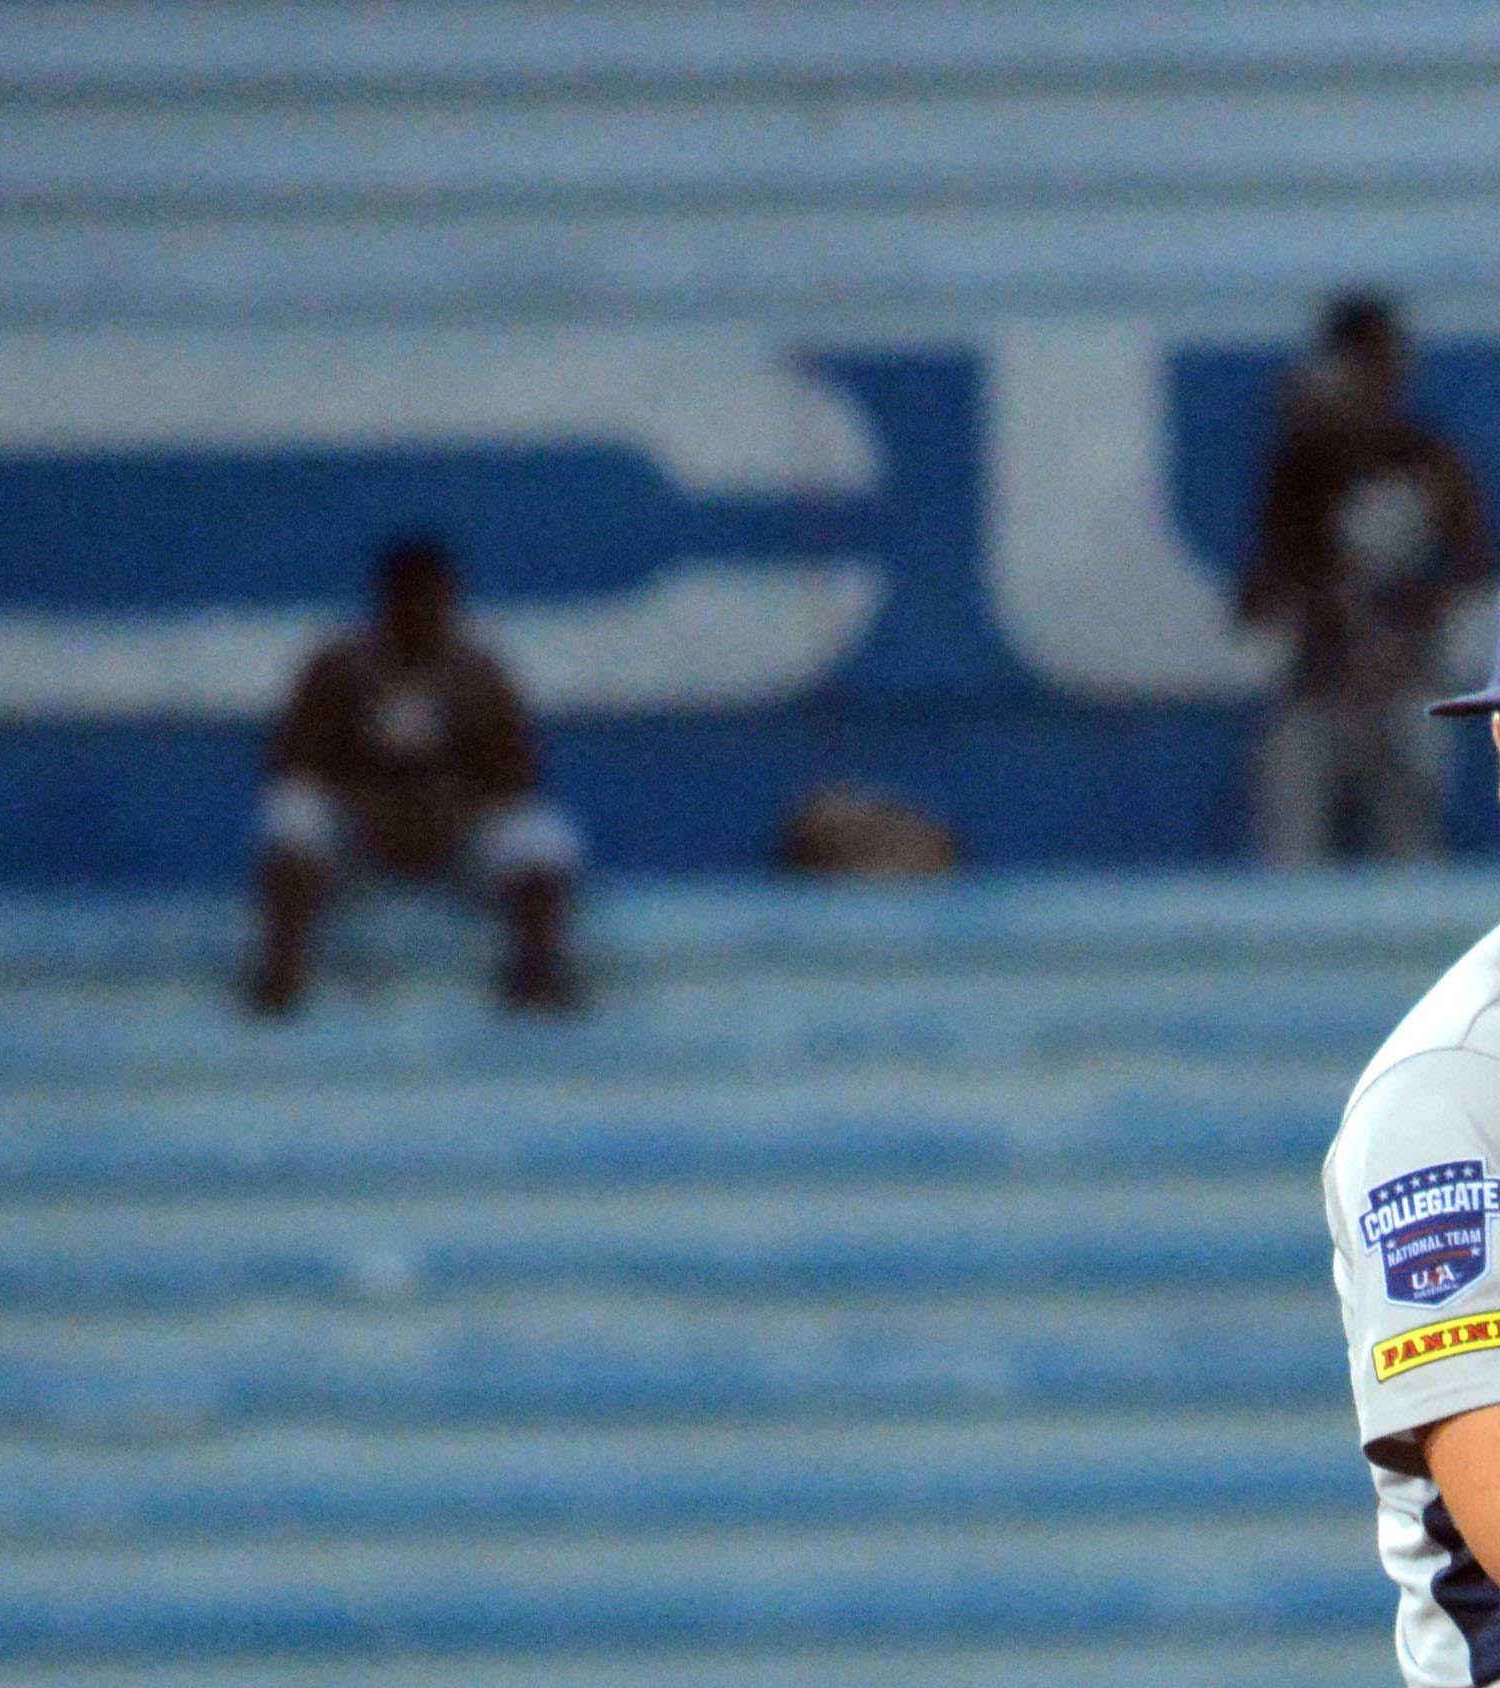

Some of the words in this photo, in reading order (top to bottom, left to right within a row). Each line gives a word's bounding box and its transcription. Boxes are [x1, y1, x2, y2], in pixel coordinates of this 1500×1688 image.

[1363, 1181, 1499, 1242] COLLEGIATE
[1387, 1234, 1444, 1267] NATIONAL
[1446, 1228, 1482, 1249] TEAM
